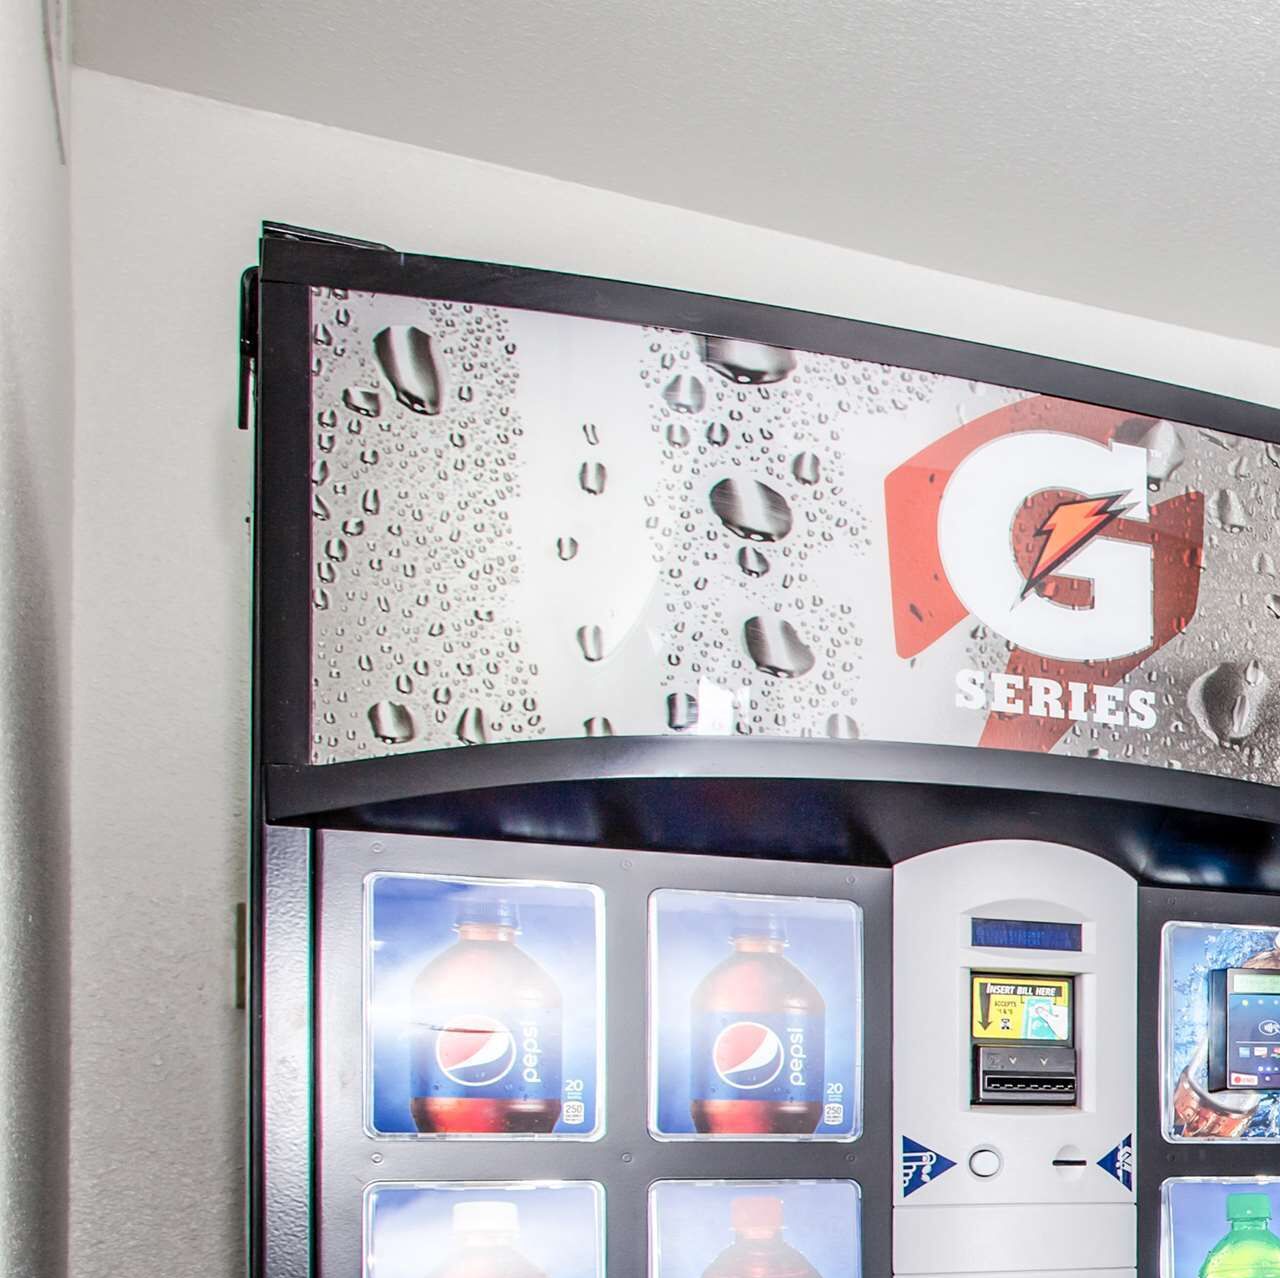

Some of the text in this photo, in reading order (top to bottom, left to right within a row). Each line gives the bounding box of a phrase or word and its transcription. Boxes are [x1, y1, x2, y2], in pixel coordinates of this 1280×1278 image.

[955, 668, 1158, 731] SERIES
[986, 983, 1057, 996] INSERT BILL HERE
[520, 1021, 542, 1083] pepsi
[787, 1027, 807, 1086] pepsi
[565, 1079, 584, 1092] 20
[826, 1082, 844, 1094] 20
[565, 1103, 583, 1114] 250
